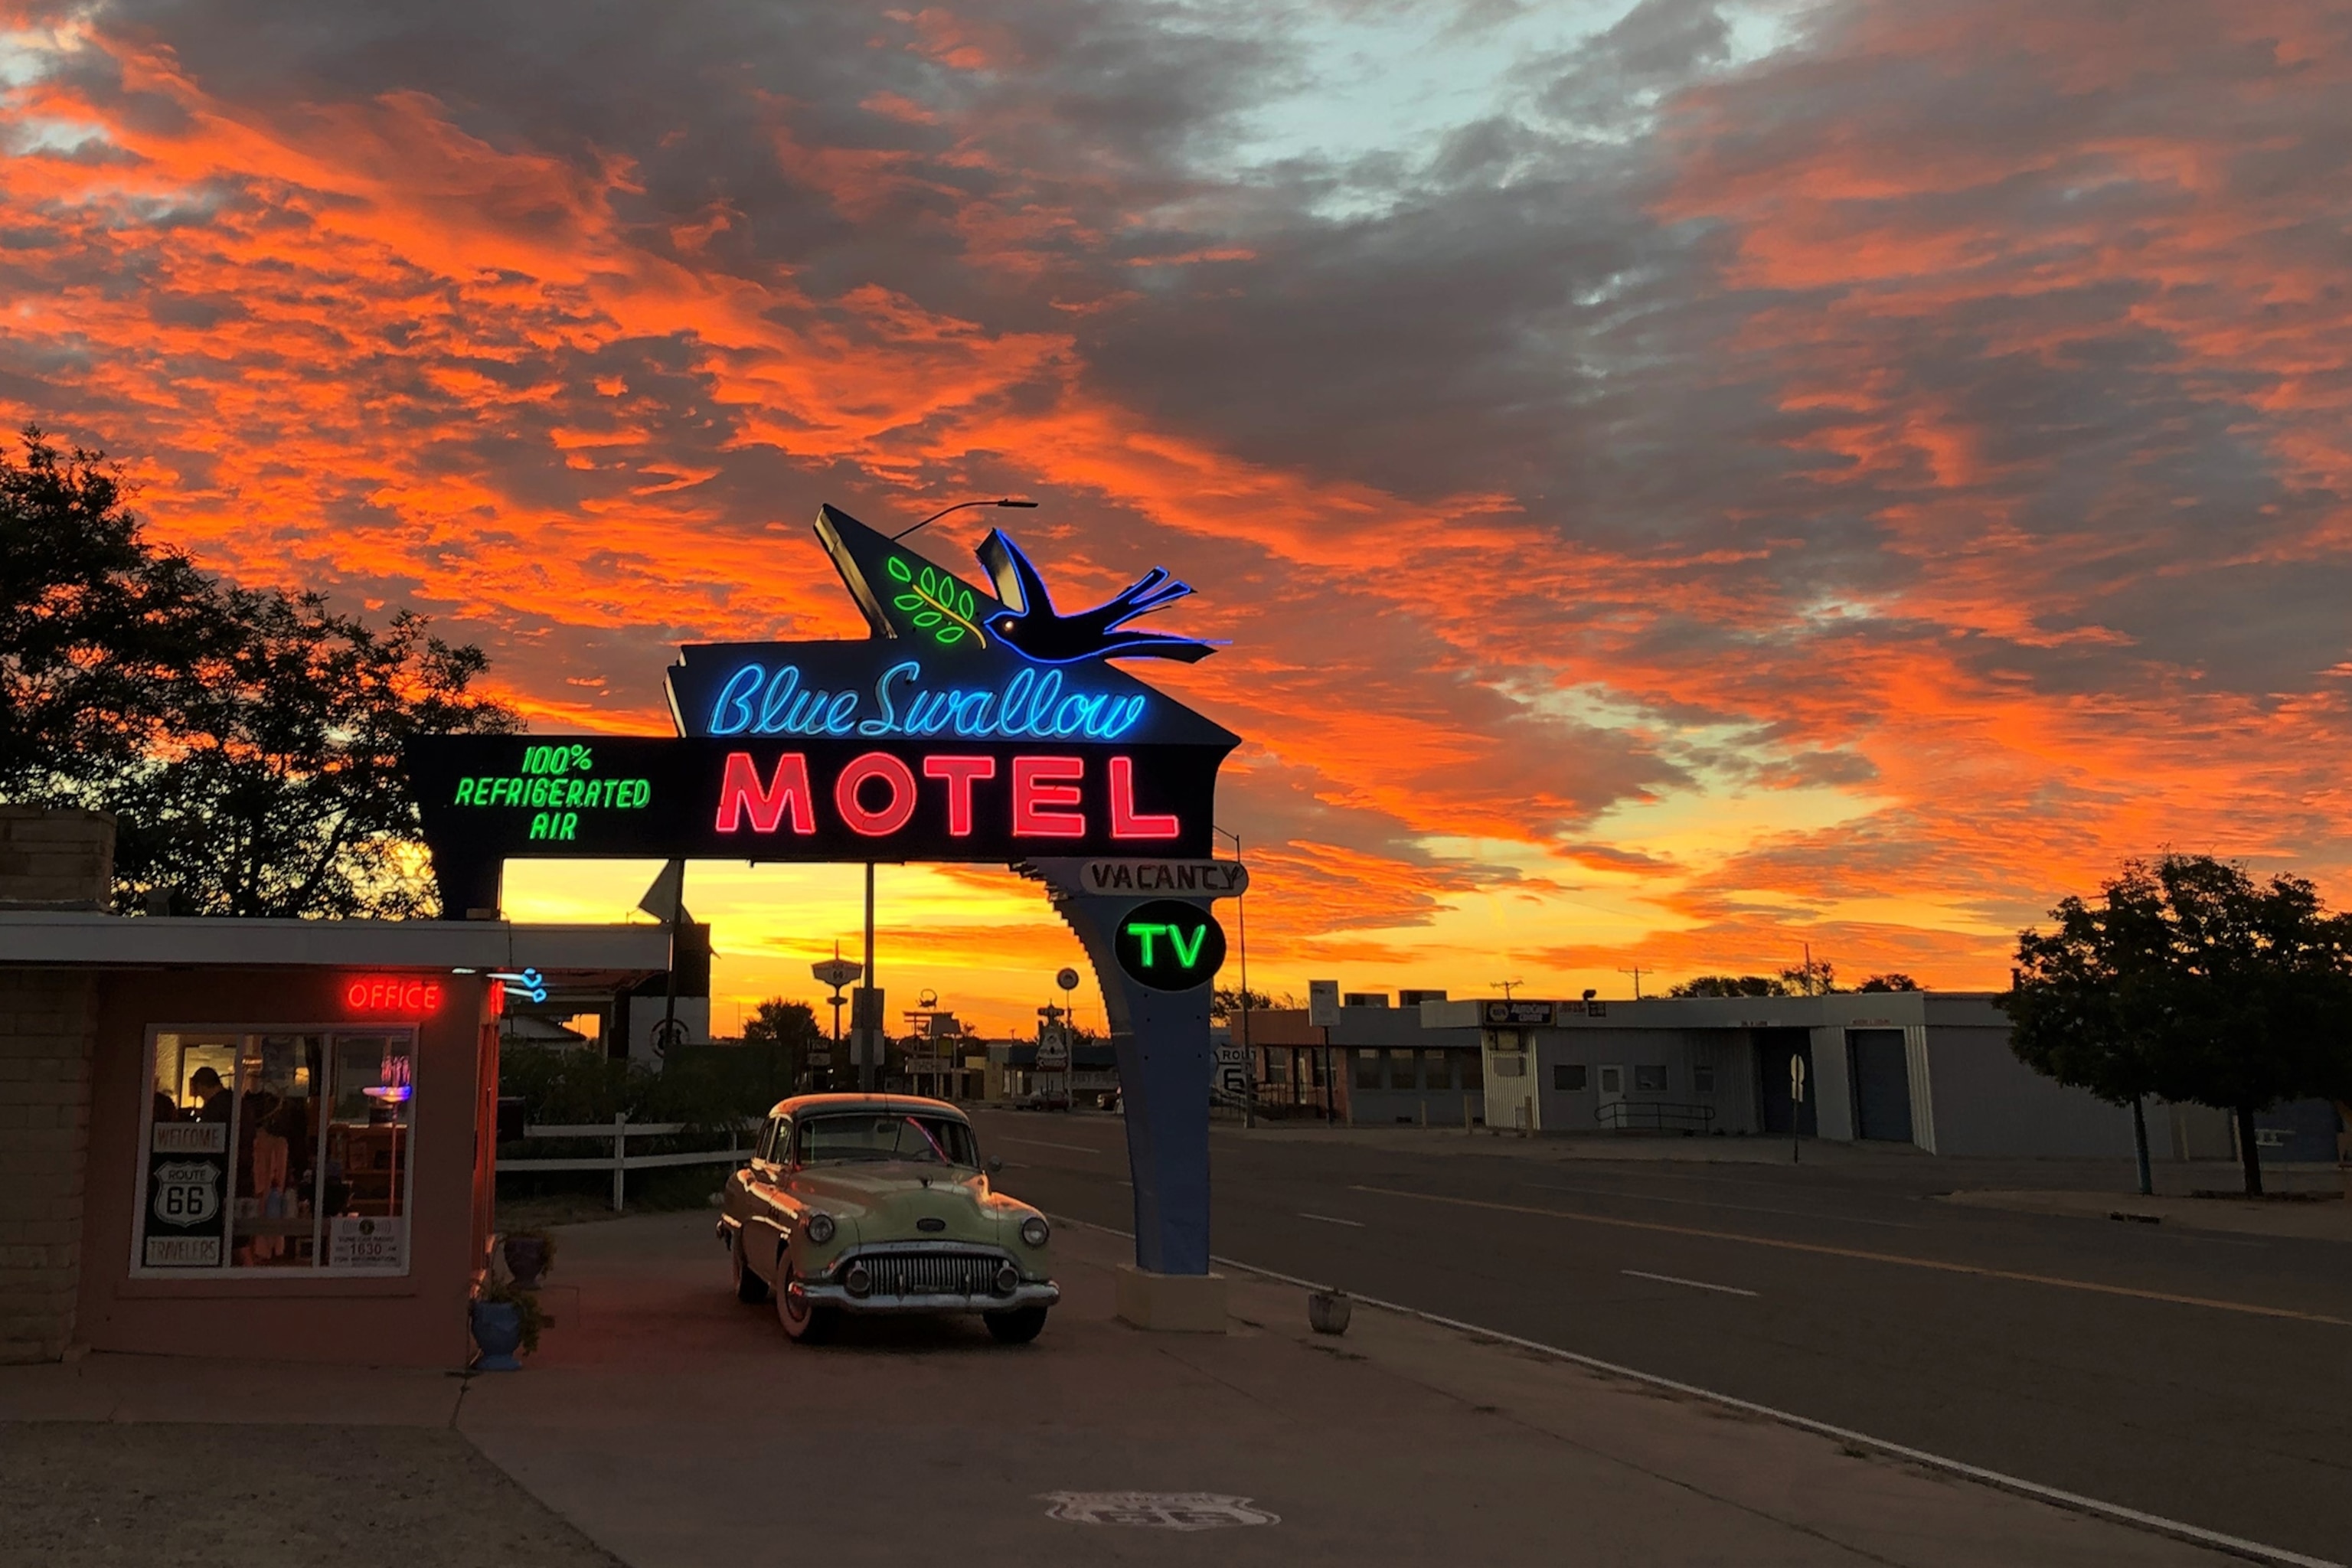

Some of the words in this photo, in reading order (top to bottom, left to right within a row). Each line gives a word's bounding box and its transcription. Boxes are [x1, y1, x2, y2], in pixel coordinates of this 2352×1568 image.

[707, 662, 858, 737] Blue
[858, 660, 1147, 740] Swallow
[521, 743, 593, 774] 100%
[455, 776, 652, 809] REFRIGERATED
[715, 750, 1181, 841] MOTEL
[529, 812, 579, 841] AIR
[1092, 862, 1245, 891] VACANCY
[1127, 923, 1208, 970] TV
[348, 983, 439, 1011] OFFICE
[1223, 1050, 1256, 1060] ROUT
[158, 1128, 220, 1148] WELCOME
[168, 1169, 207, 1181] ROUTE
[167, 1186, 204, 1215] 66
[151, 1240, 215, 1261] TRAVELERS
[351, 1243, 382, 1255] 1630
